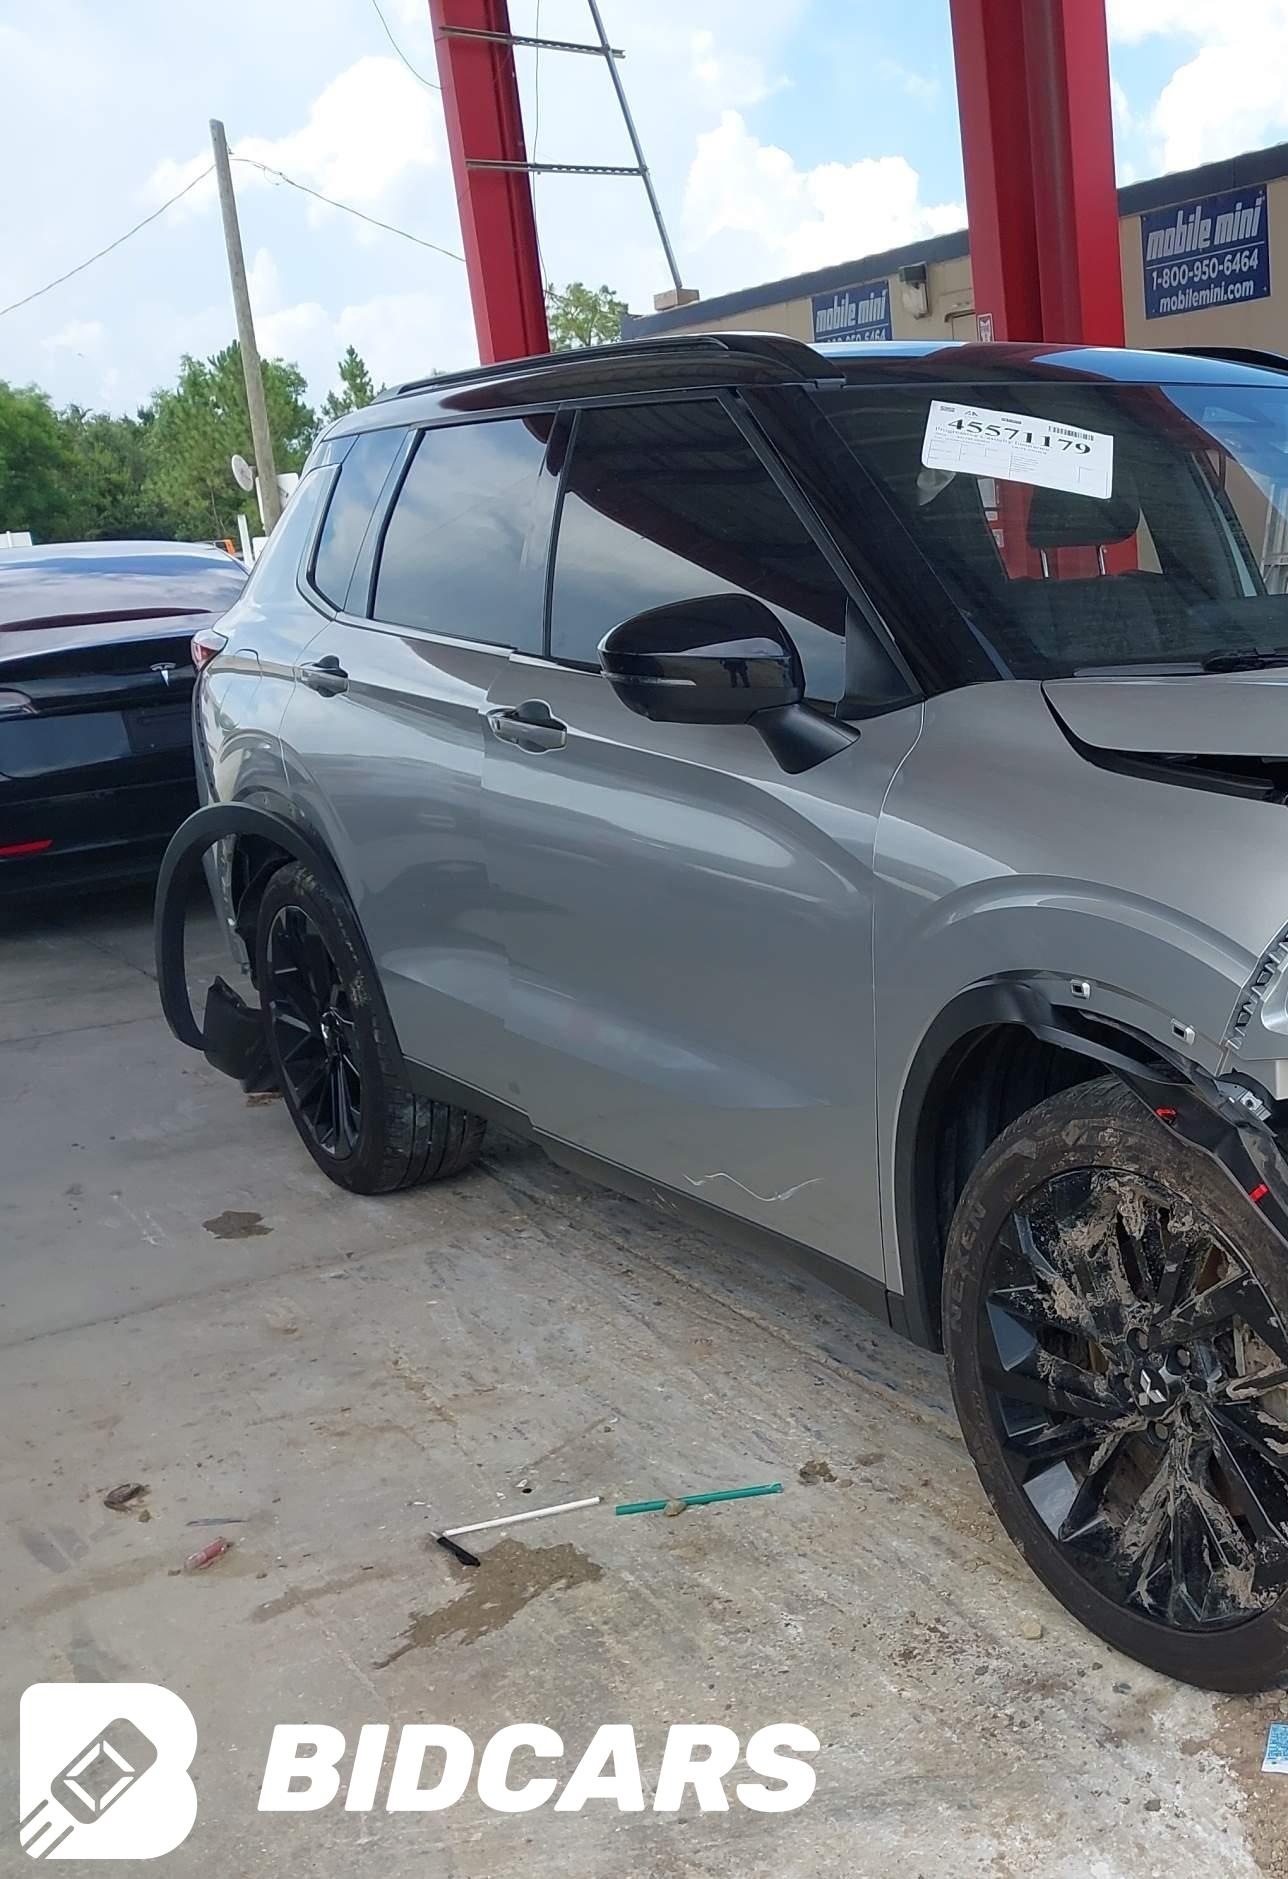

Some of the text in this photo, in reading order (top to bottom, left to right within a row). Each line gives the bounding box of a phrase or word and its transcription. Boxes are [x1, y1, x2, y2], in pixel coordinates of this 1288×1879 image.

[1146, 197, 1263, 261] mobile mini
[1152, 248, 1259, 291] 1-800-950-6464
[815, 288, 888, 333] mobile mini
[1159, 280, 1255, 313] mobilemini.com
[947, 418, 1092, 455] 45571179
